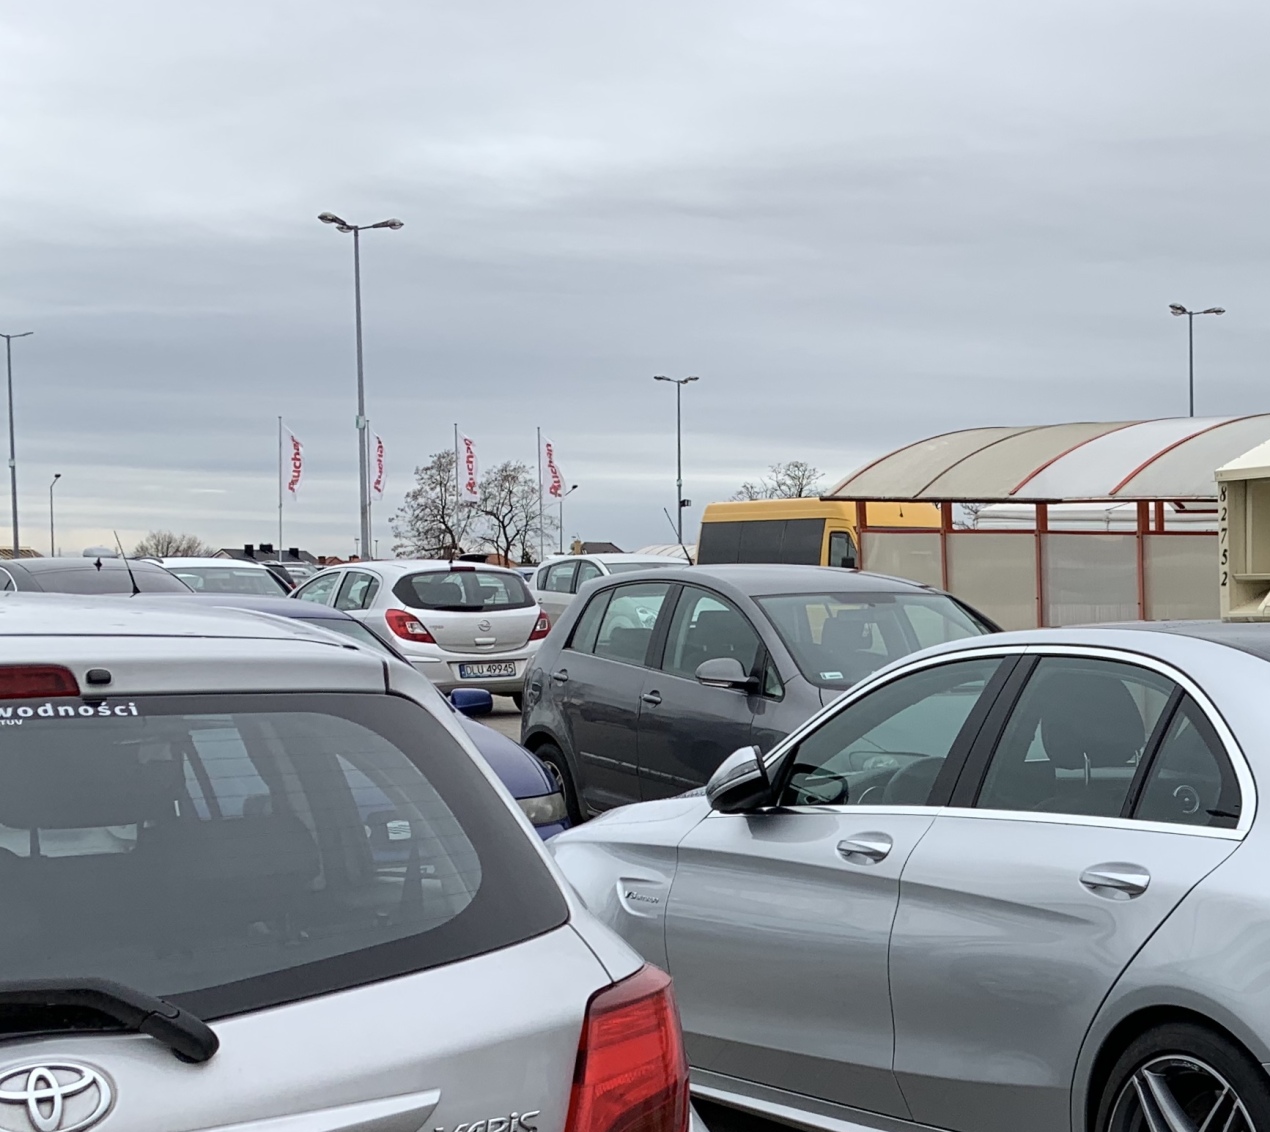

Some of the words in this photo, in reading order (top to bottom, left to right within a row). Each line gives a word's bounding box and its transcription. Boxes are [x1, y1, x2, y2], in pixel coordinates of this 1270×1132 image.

[1219, 486, 1229, 587] 82752
[465, 665, 484, 675] DLU
[486, 663, 514, 674] 49945
